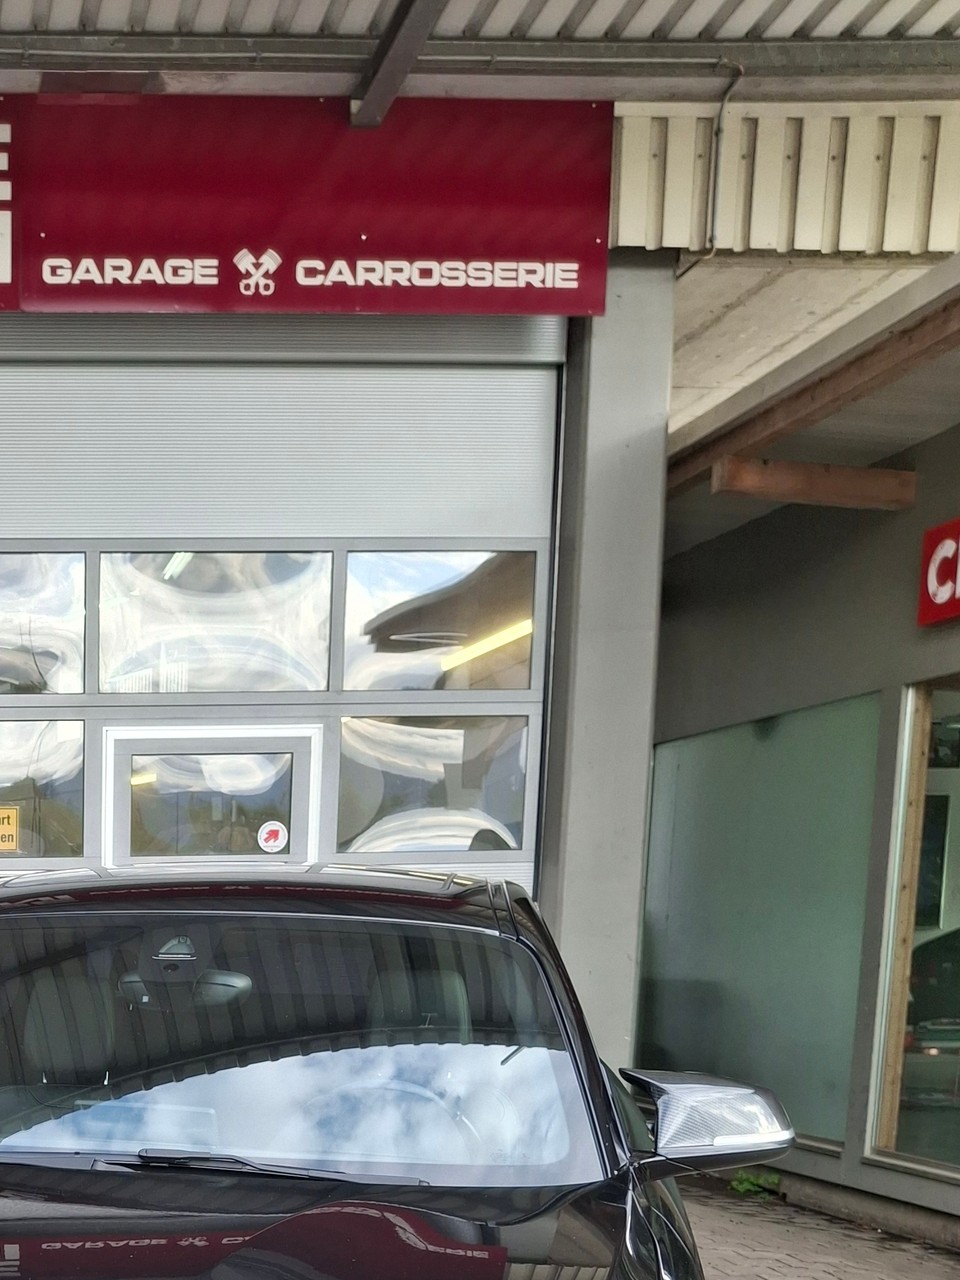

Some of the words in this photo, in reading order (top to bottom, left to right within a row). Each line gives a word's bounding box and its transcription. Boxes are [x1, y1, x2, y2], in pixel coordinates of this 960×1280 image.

[41, 257, 220, 285] GARAGE
[295, 259, 579, 289] CARROSSERIE
[926, 538, 960, 605] C
